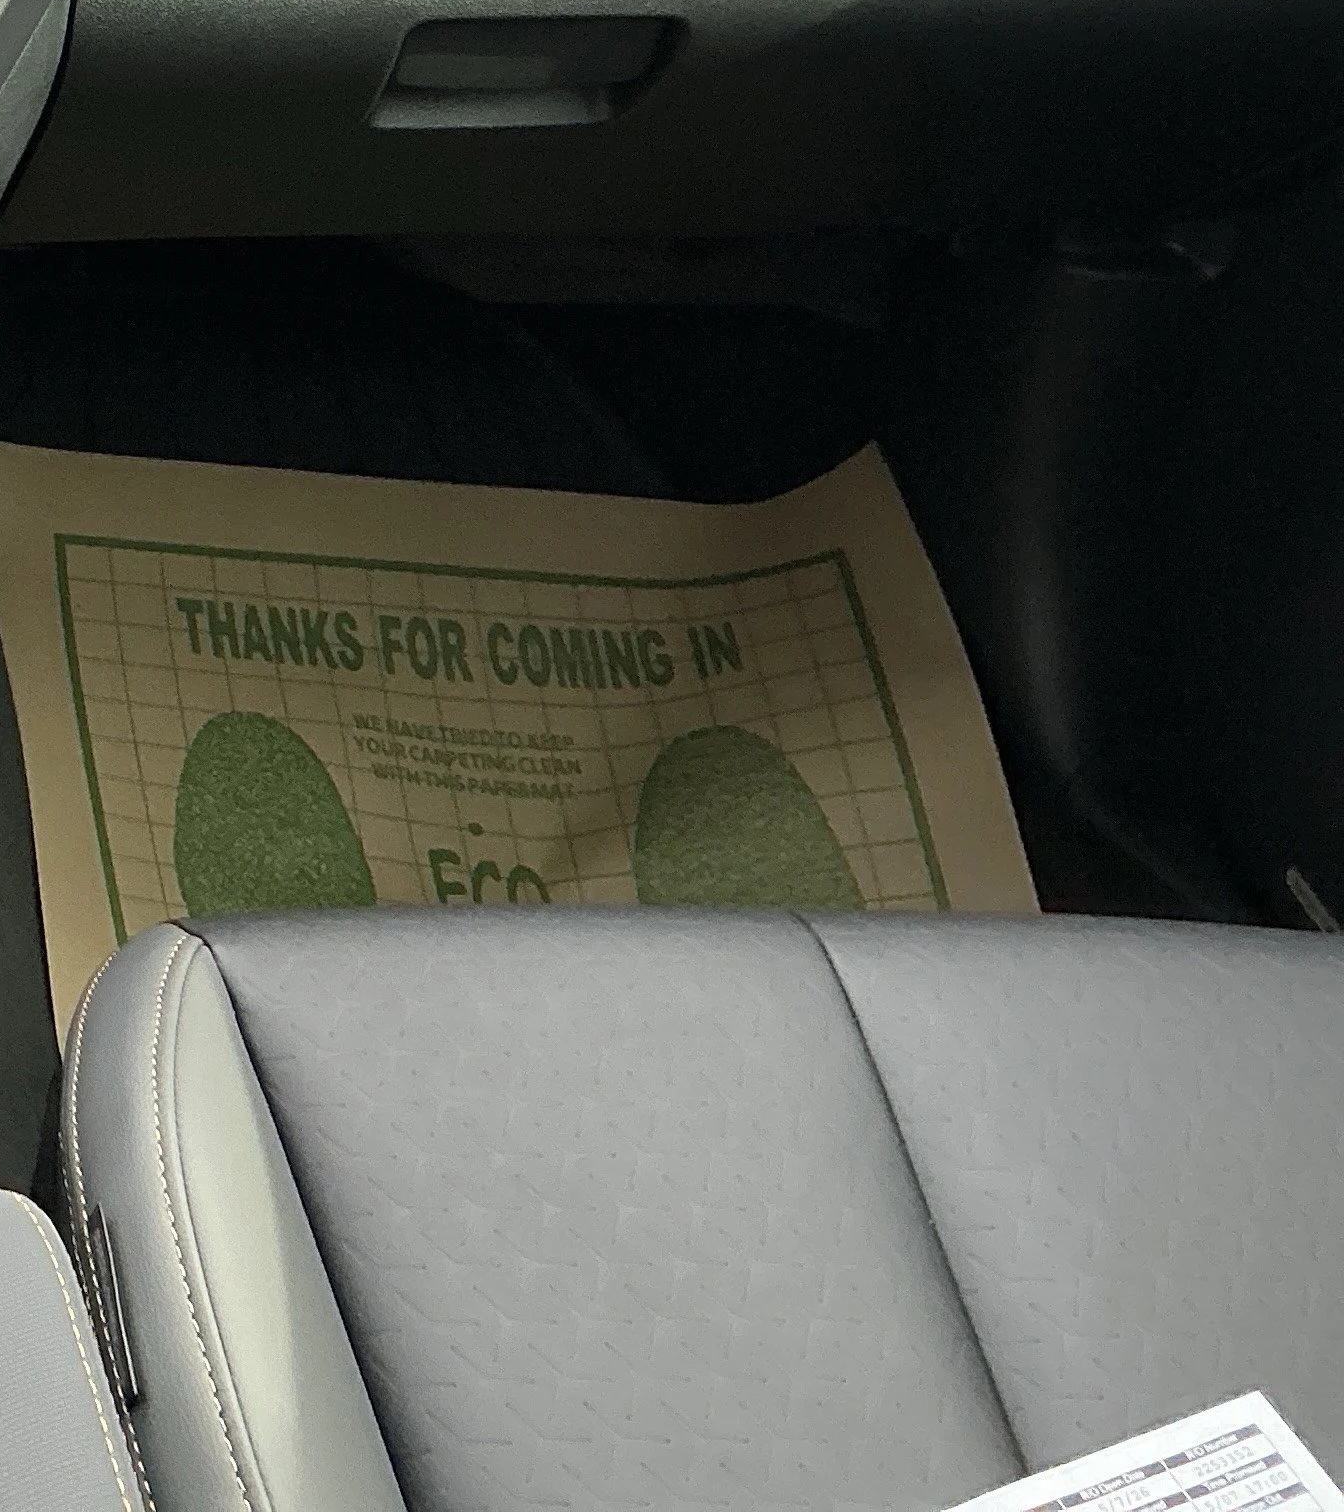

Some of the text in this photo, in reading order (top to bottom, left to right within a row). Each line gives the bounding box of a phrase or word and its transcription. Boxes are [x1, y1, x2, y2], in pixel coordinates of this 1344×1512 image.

[175, 597, 743, 689] THANKS FOR COMING IN
